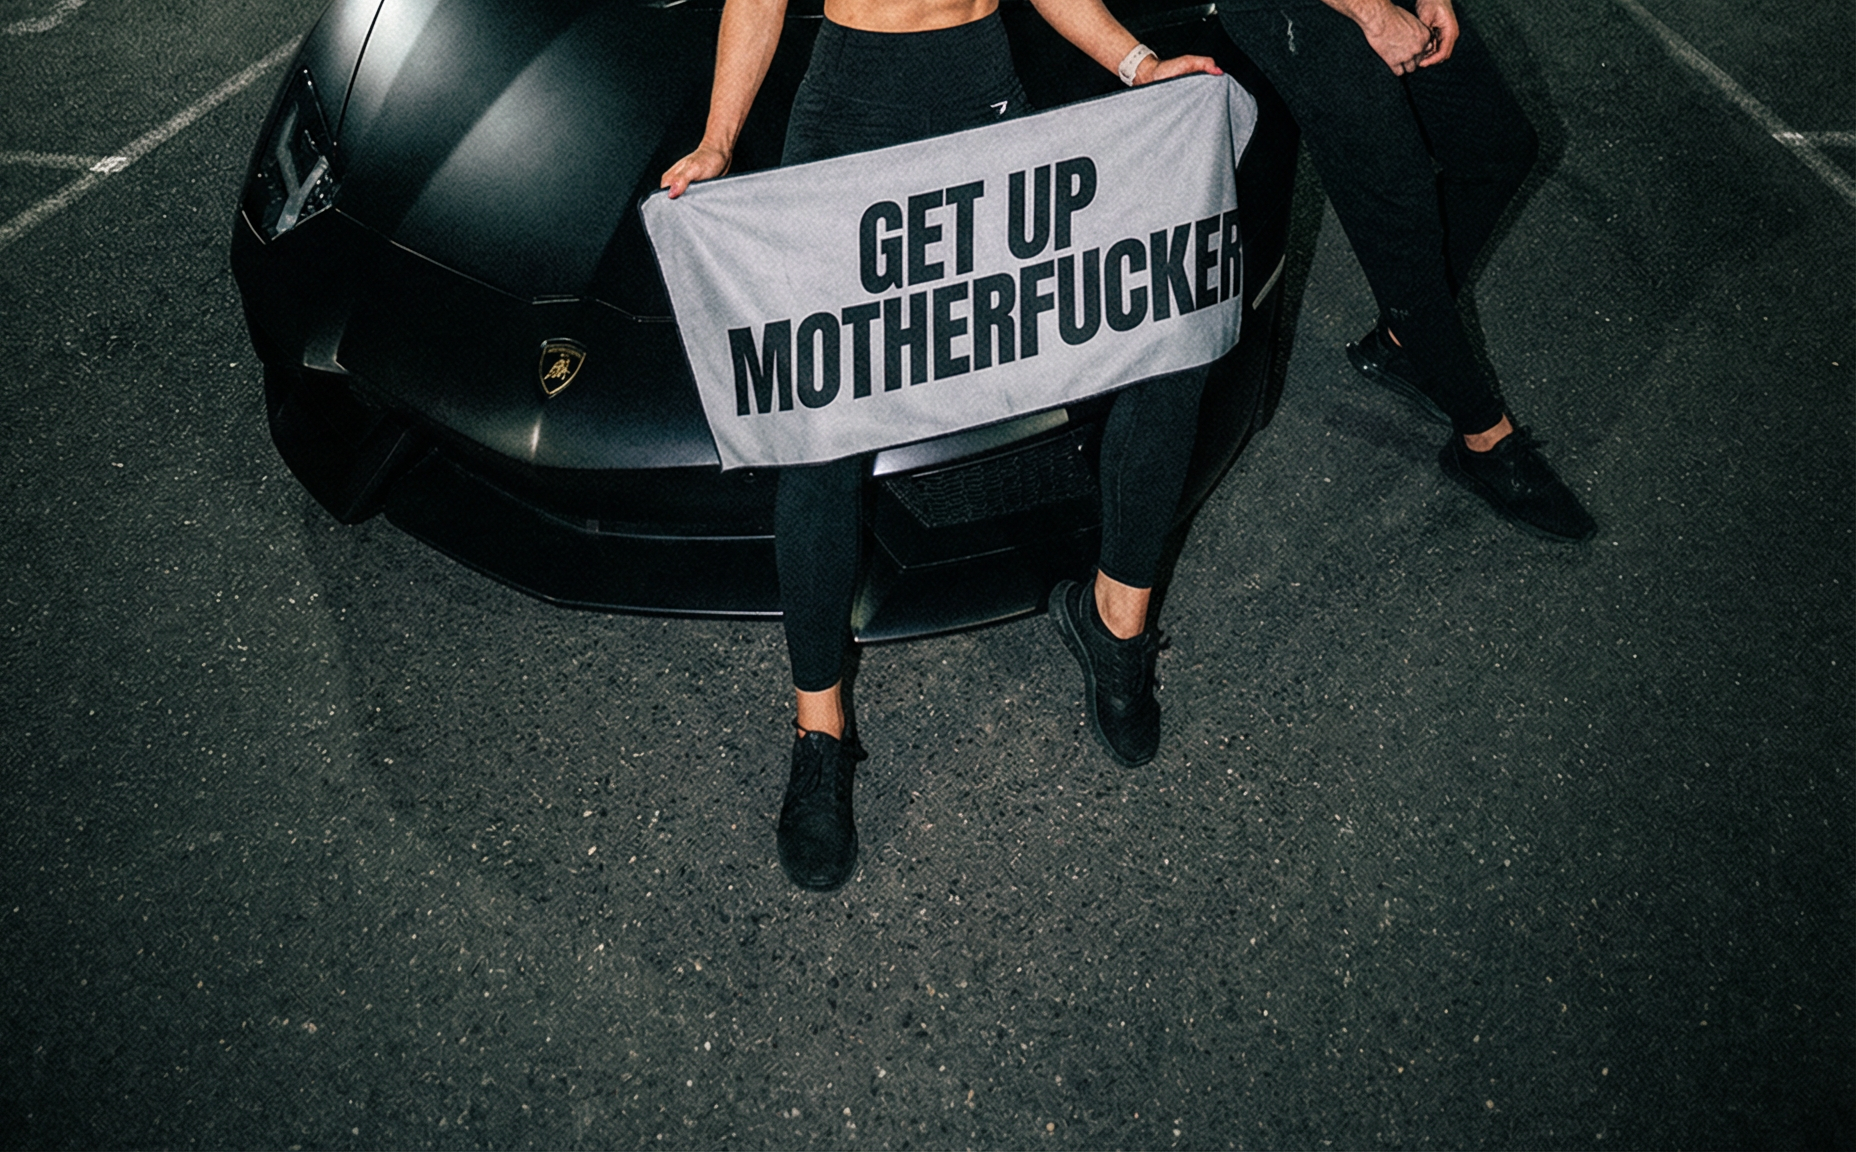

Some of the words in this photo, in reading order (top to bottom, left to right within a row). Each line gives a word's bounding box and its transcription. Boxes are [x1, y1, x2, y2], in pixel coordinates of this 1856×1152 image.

[859, 179, 985, 294] GET
[1007, 156, 1098, 260] UP
[727, 209, 1241, 417] MOTHERFUCKER
